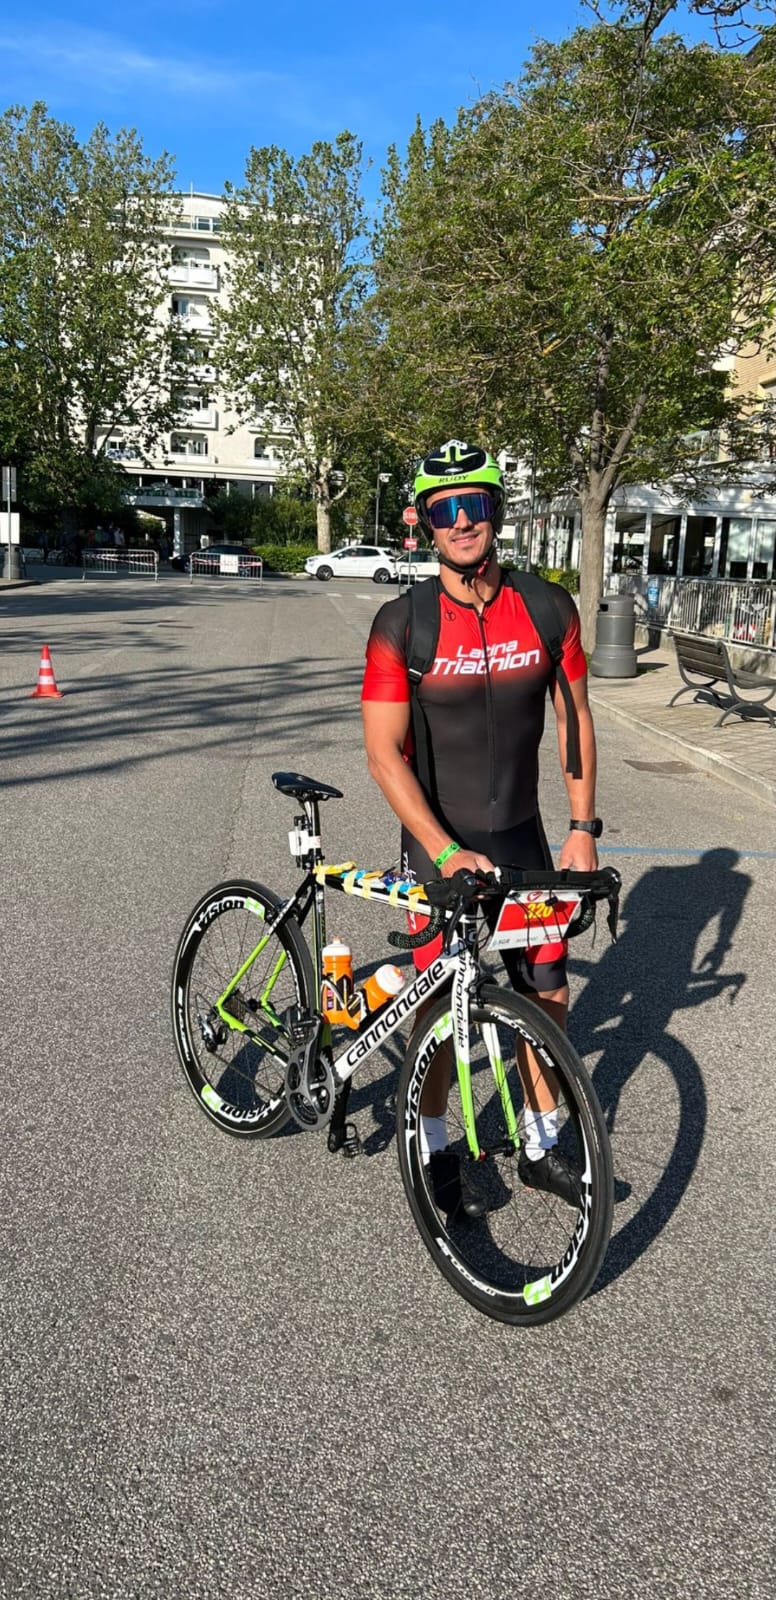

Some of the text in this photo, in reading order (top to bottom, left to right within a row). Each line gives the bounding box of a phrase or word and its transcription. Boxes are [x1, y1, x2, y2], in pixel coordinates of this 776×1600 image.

[439, 474, 469, 484] RUDY
[456, 640, 519, 659] Latina
[432, 649, 540, 676] Triathlon
[524, 903, 554, 920] 320
[346, 961, 446, 1067] cannondale
